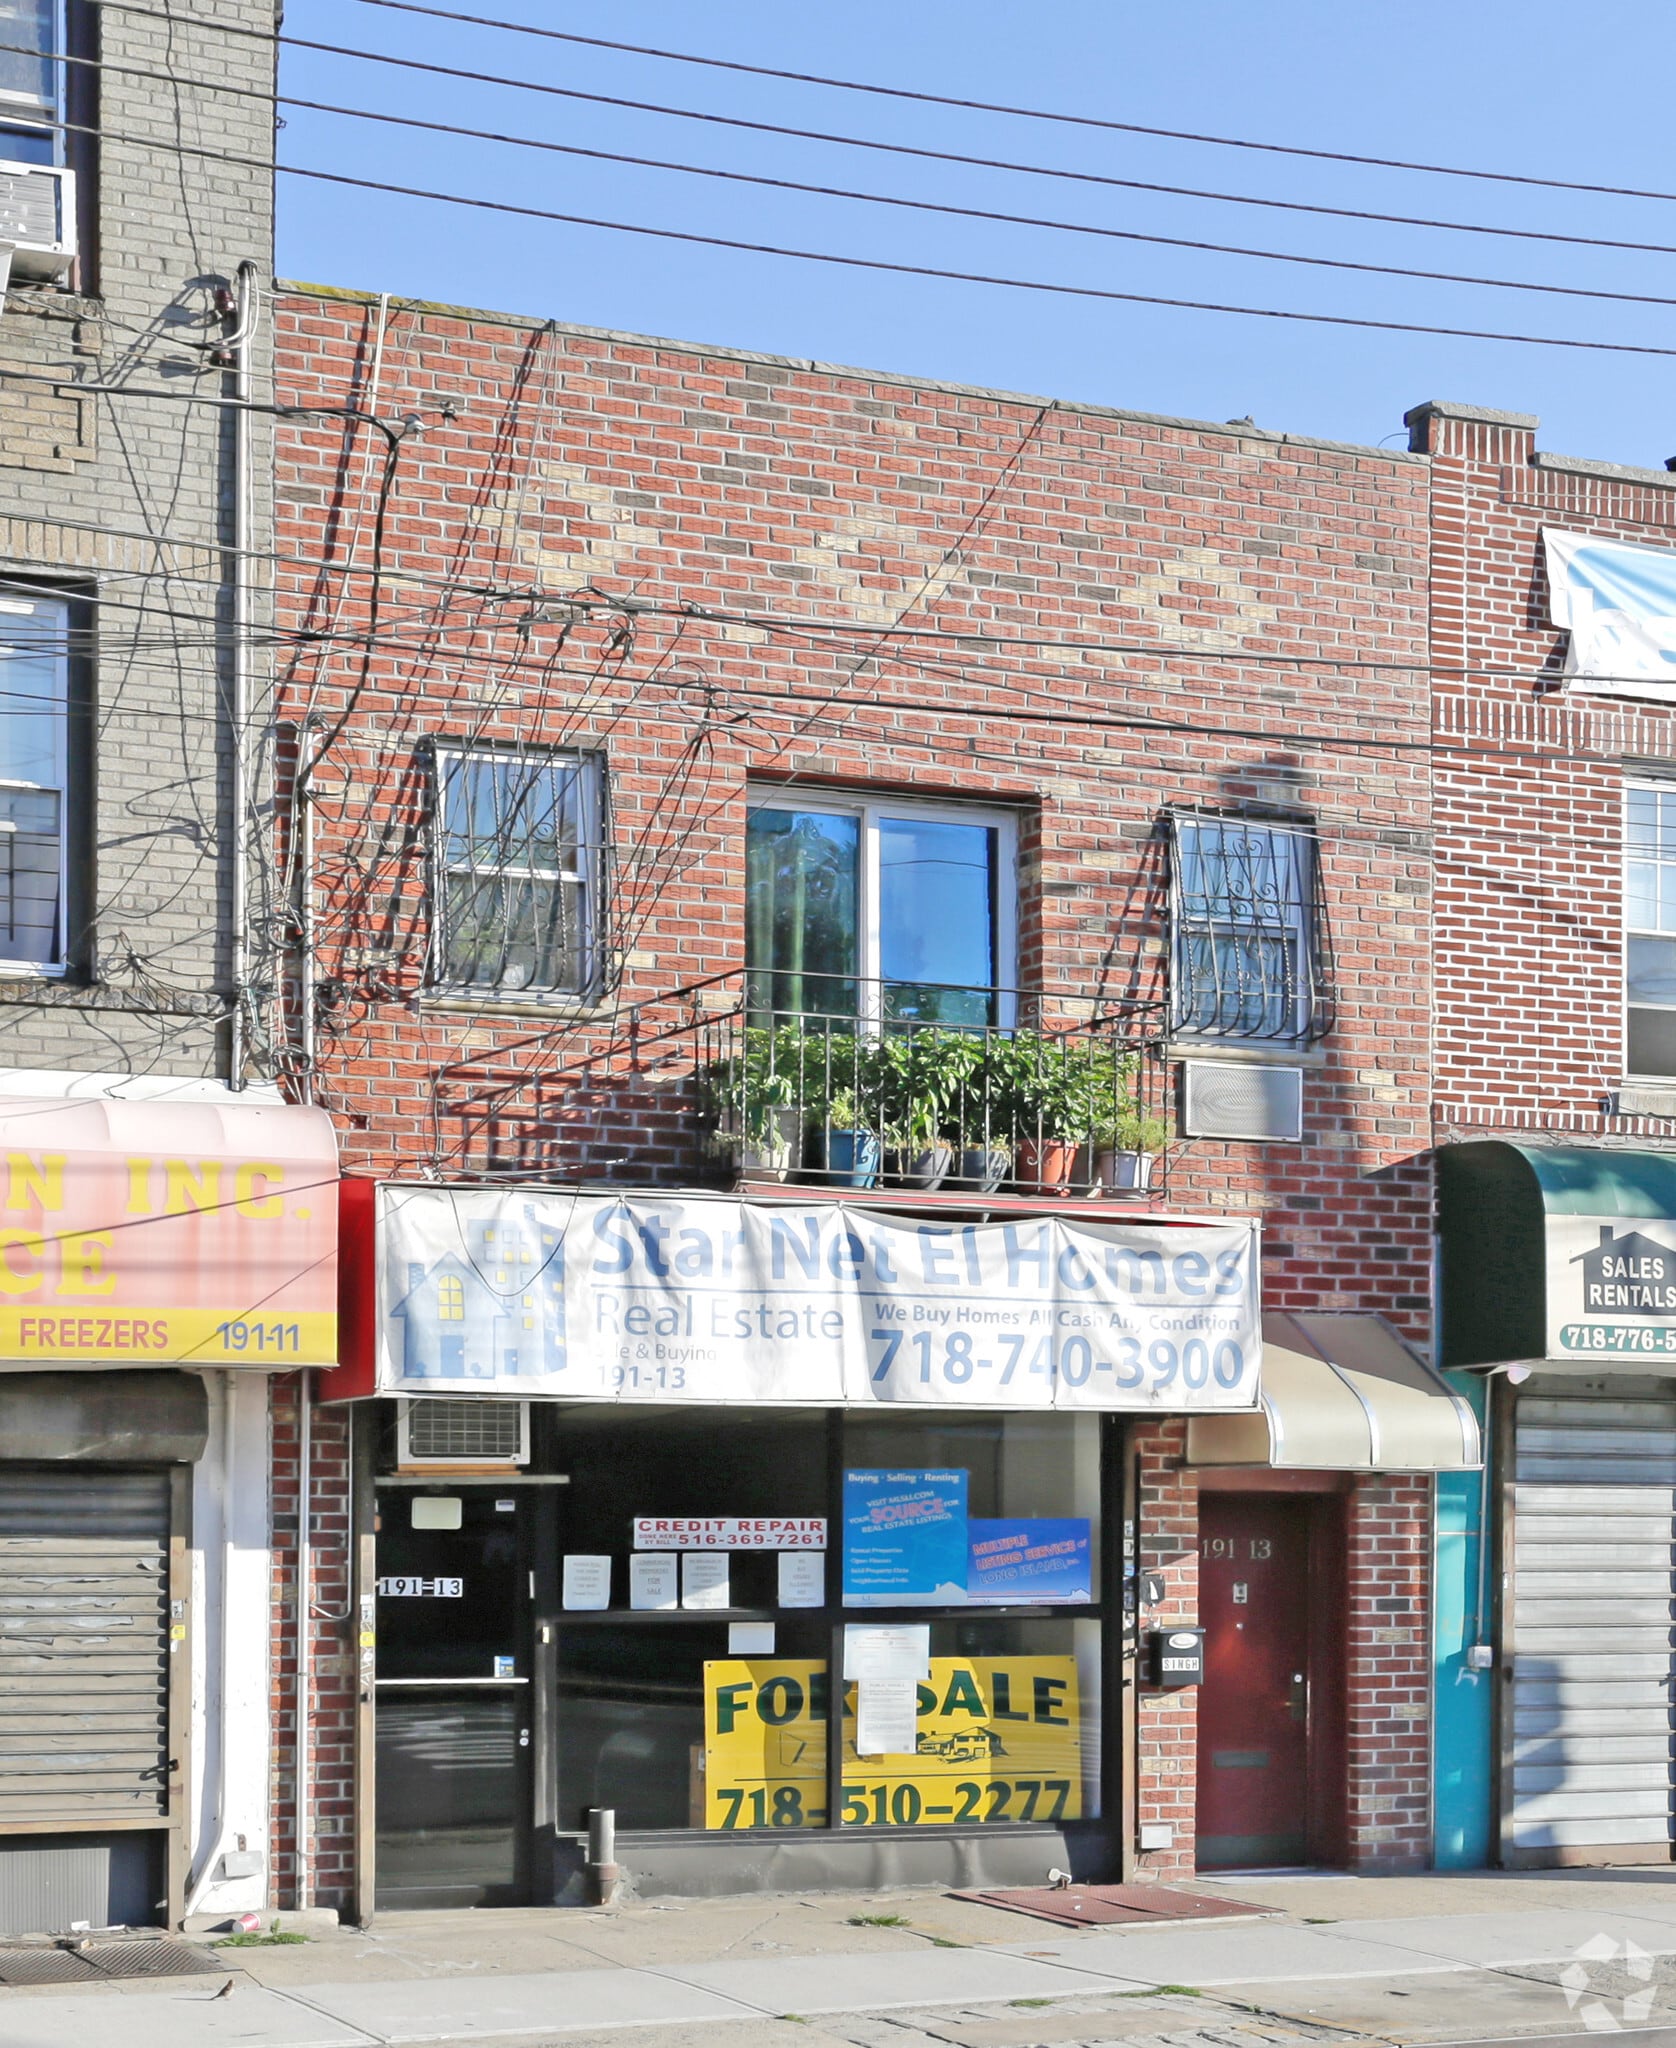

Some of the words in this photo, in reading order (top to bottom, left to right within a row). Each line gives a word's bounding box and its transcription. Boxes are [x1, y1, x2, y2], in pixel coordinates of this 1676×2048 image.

[126, 1157, 312, 1219] INC.
[0, 1227, 117, 1296] CE
[592, 1205, 745, 1278] Star
[769, 1217, 898, 1284] Net
[917, 1226, 982, 1286] El
[1003, 1225, 1244, 1297] Homes
[1602, 1255, 1664, 1280] SALES
[1589, 1283, 1676, 1308] RENTALS
[596, 1293, 692, 1337] Real
[711, 1298, 844, 1340] Estate
[875, 1303, 907, 1320] We
[913, 1304, 951, 1326] Buy
[957, 1306, 1019, 1324] Homes
[1029, 1310, 1052, 1326] All
[1150, 1314, 1240, 1331] Condition
[20, 1318, 168, 1348] FREEZERS
[216, 1322, 299, 1351] 191-11
[1567, 1327, 1676, 1351] 718-776-5
[635, 1343, 650, 1360] &
[872, 1328, 1244, 1390] 718-740-3900
[598, 1365, 686, 1389] 191-13
[847, 1473, 879, 1484] Buying
[886, 1473, 917, 1484] Selling
[924, 1473, 960, 1484] Renting
[861, 1523, 883, 1533] REAL
[884, 1519, 915, 1530] ESTATE
[916, 1512, 952, 1525] LISTINGS
[870, 1498, 945, 1525] SOURCE
[638, 1520, 726, 1532] CREDIT
[738, 1520, 823, 1531] REPAIR
[679, 1534, 824, 1545] 516-369-7261
[972, 1534, 1028, 1556] MULTIPLE
[1201, 1538, 1235, 1559] 191
[1249, 1539, 1272, 1559] 13
[976, 1551, 1023, 1571] LISTING
[1024, 1540, 1076, 1561] SERVICE
[980, 1566, 1017, 1585] LONG
[1164, 1657, 1199, 1669] SINGH
